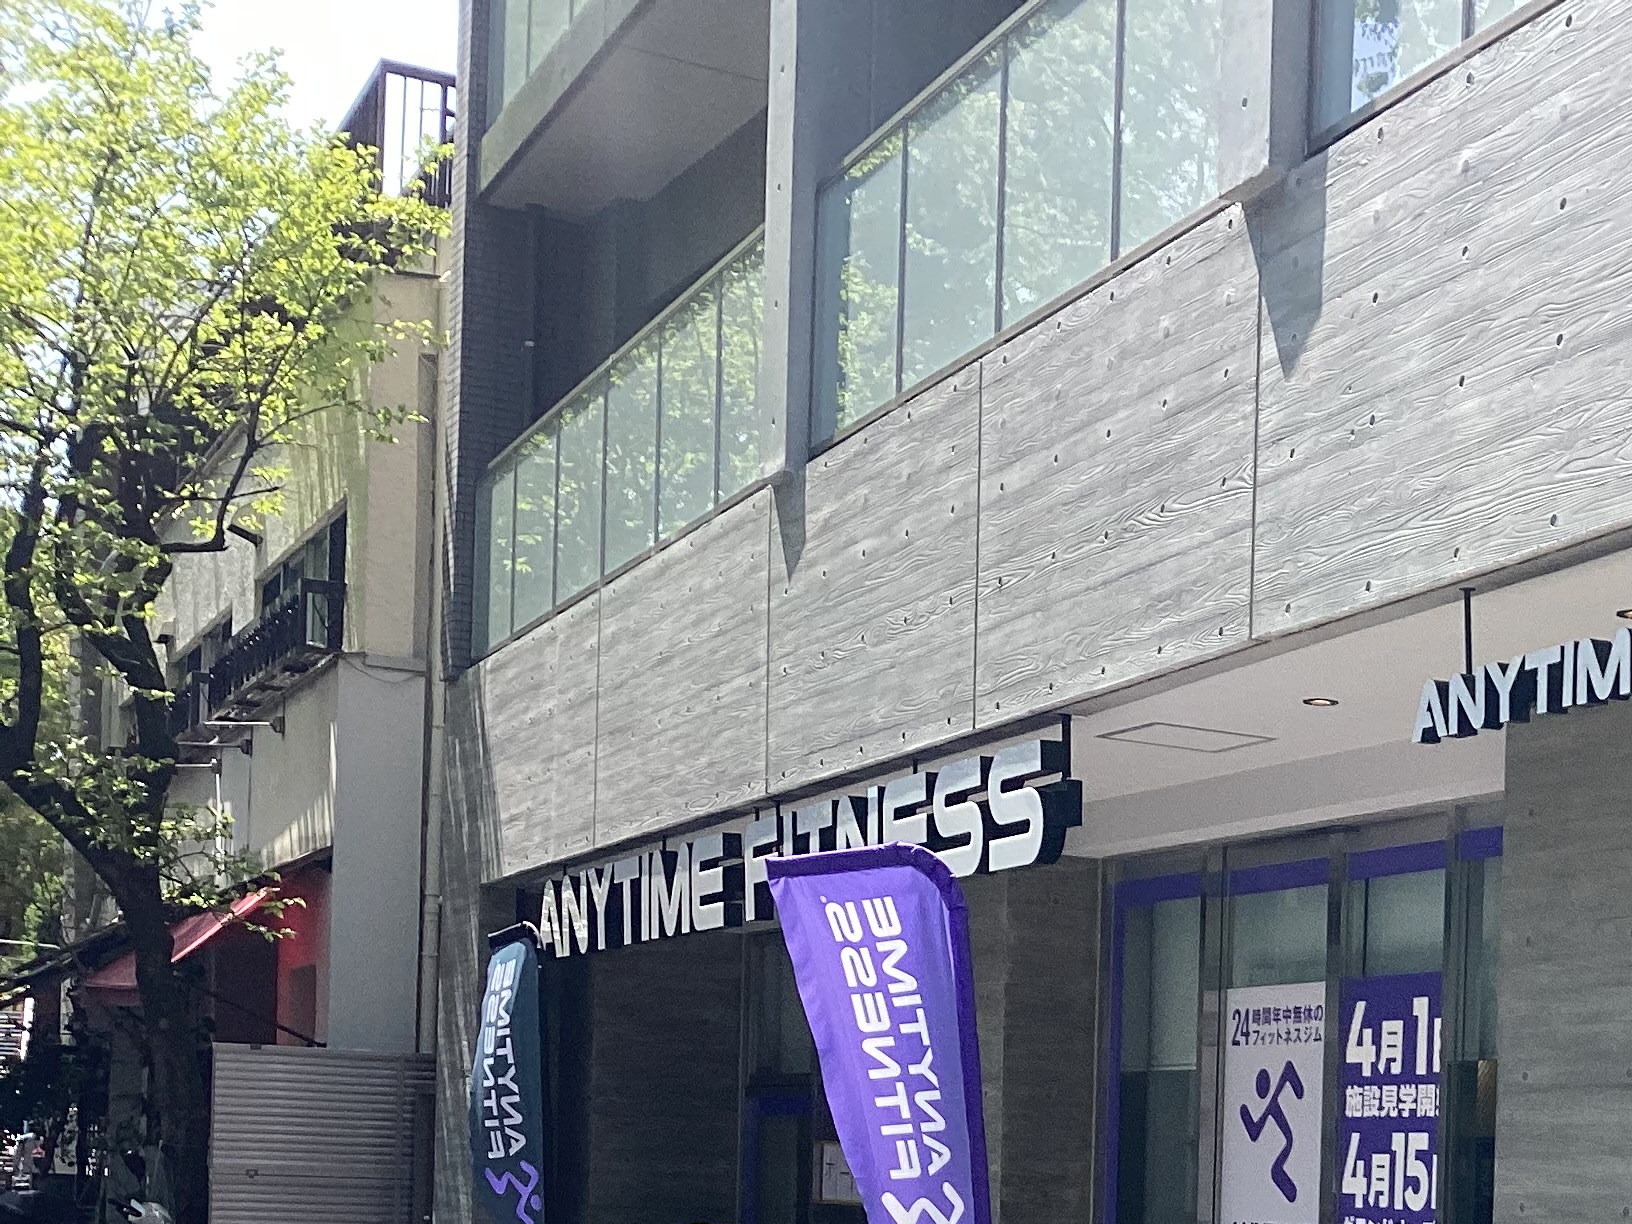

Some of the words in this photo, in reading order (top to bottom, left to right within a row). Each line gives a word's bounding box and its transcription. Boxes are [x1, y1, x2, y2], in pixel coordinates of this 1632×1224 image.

[539, 832, 725, 958] ANYTIME
[1231, 1008, 1250, 1046] 24
[1251, 1004, 1323, 1027] 時間年中無休の
[1251, 1026, 1323, 1045] フィットネスジム
[1346, 996, 1441, 1077] 4月1
[1345, 1084, 1440, 1118] 施設見学開
[1342, 1132, 1437, 1211] 4月15
